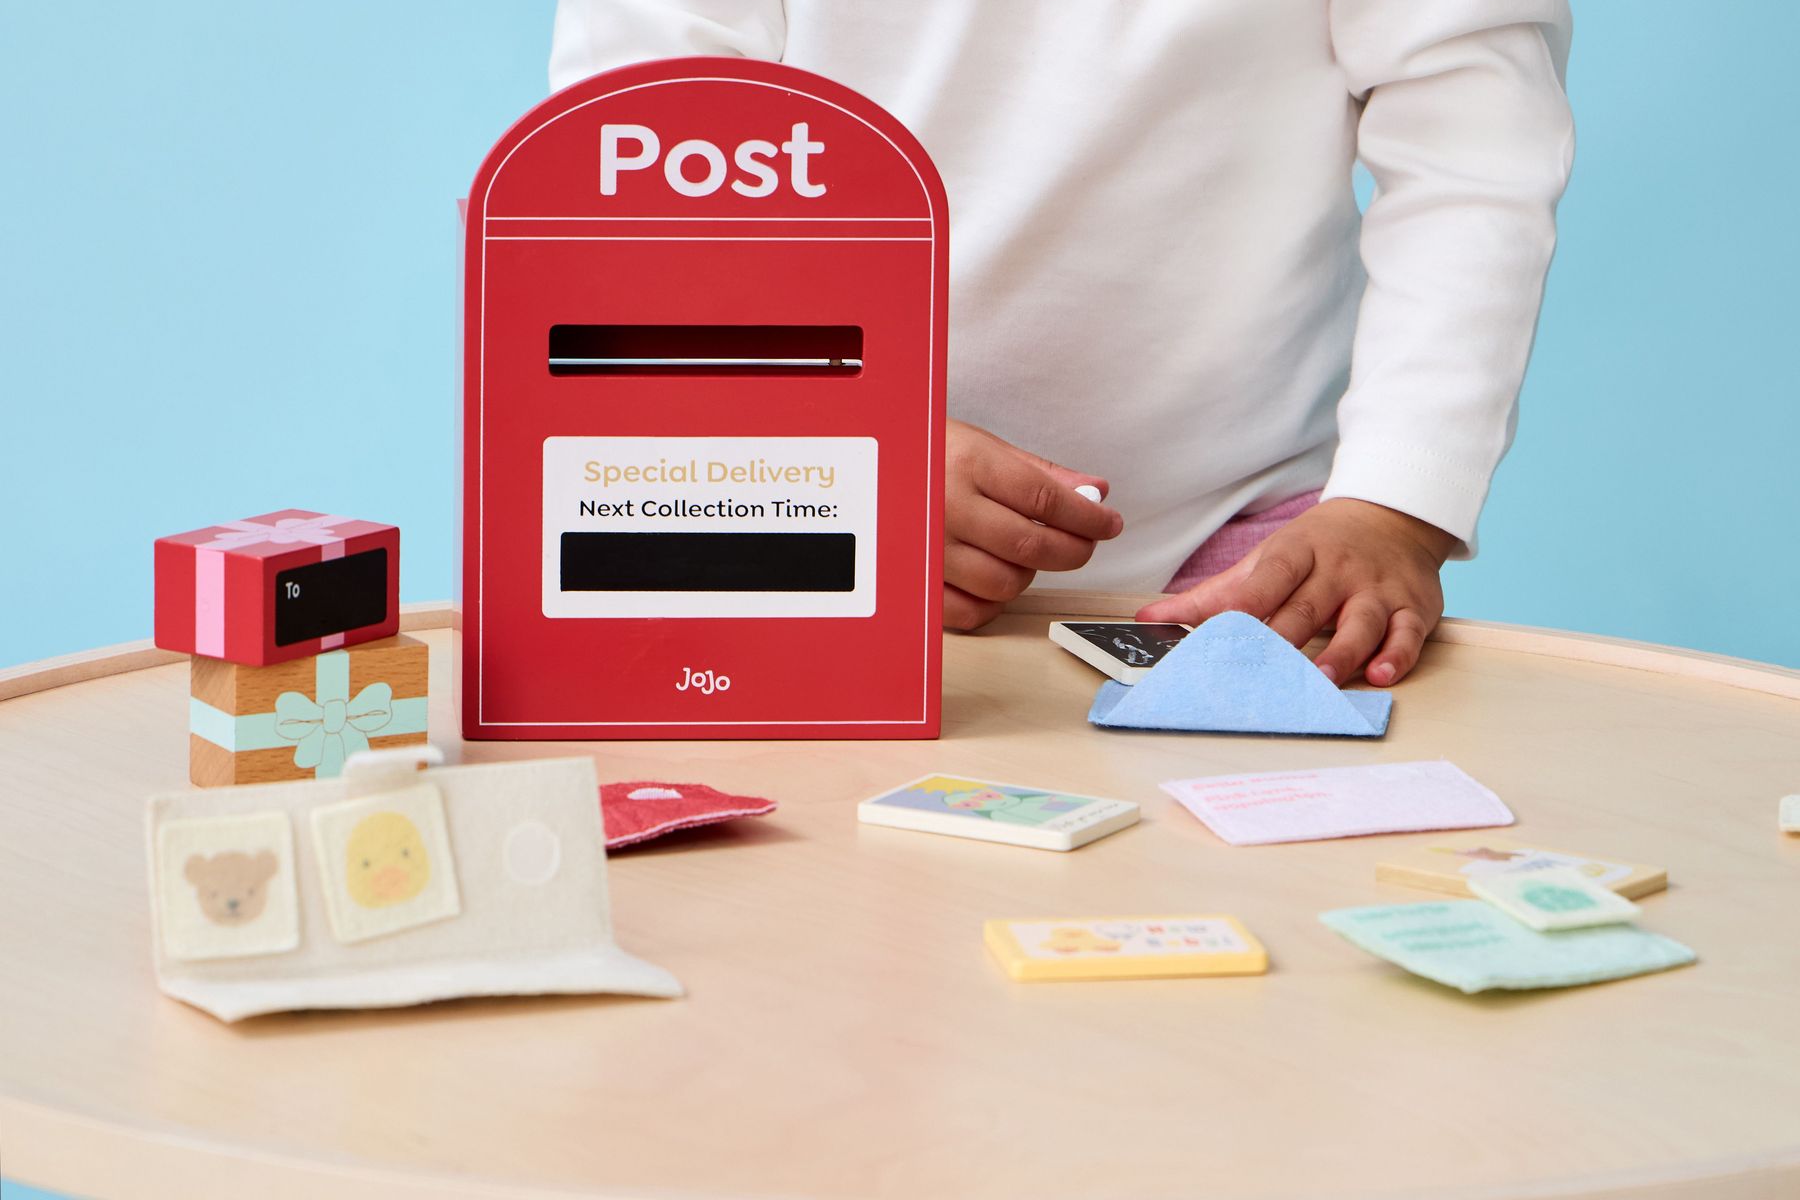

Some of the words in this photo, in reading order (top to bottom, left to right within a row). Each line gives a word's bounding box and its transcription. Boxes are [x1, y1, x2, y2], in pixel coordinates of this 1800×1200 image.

[599, 121, 827, 199] Post
[584, 458, 698, 488] Special
[706, 458, 835, 489] Delivery
[579, 500, 635, 517] Next
[641, 499, 765, 518] Collection
[771, 499, 838, 518] Time:
[285, 581, 300, 599] To
